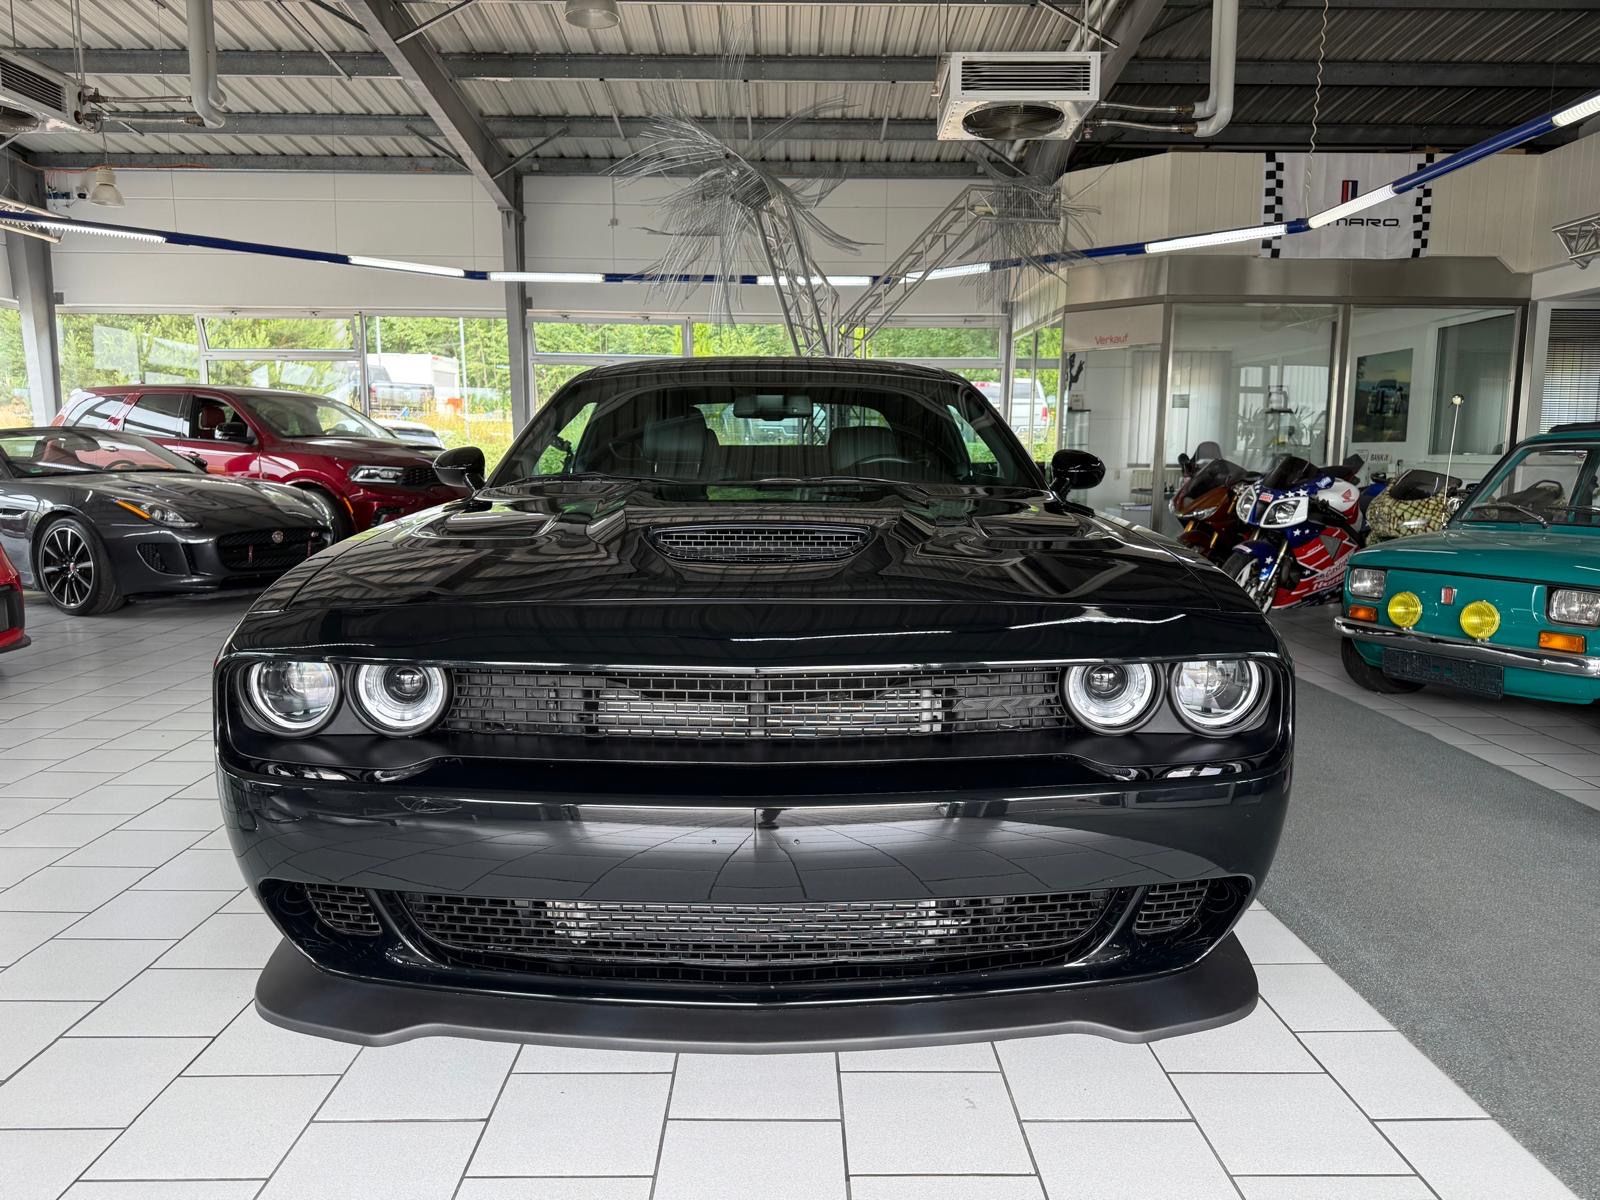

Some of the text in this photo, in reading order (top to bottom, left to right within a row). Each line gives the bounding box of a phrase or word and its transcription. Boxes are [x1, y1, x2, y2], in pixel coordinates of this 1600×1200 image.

[1324, 217, 1400, 228] MARO
[1094, 332, 1129, 345] Verkauf
[951, 694, 1056, 715] SRT
